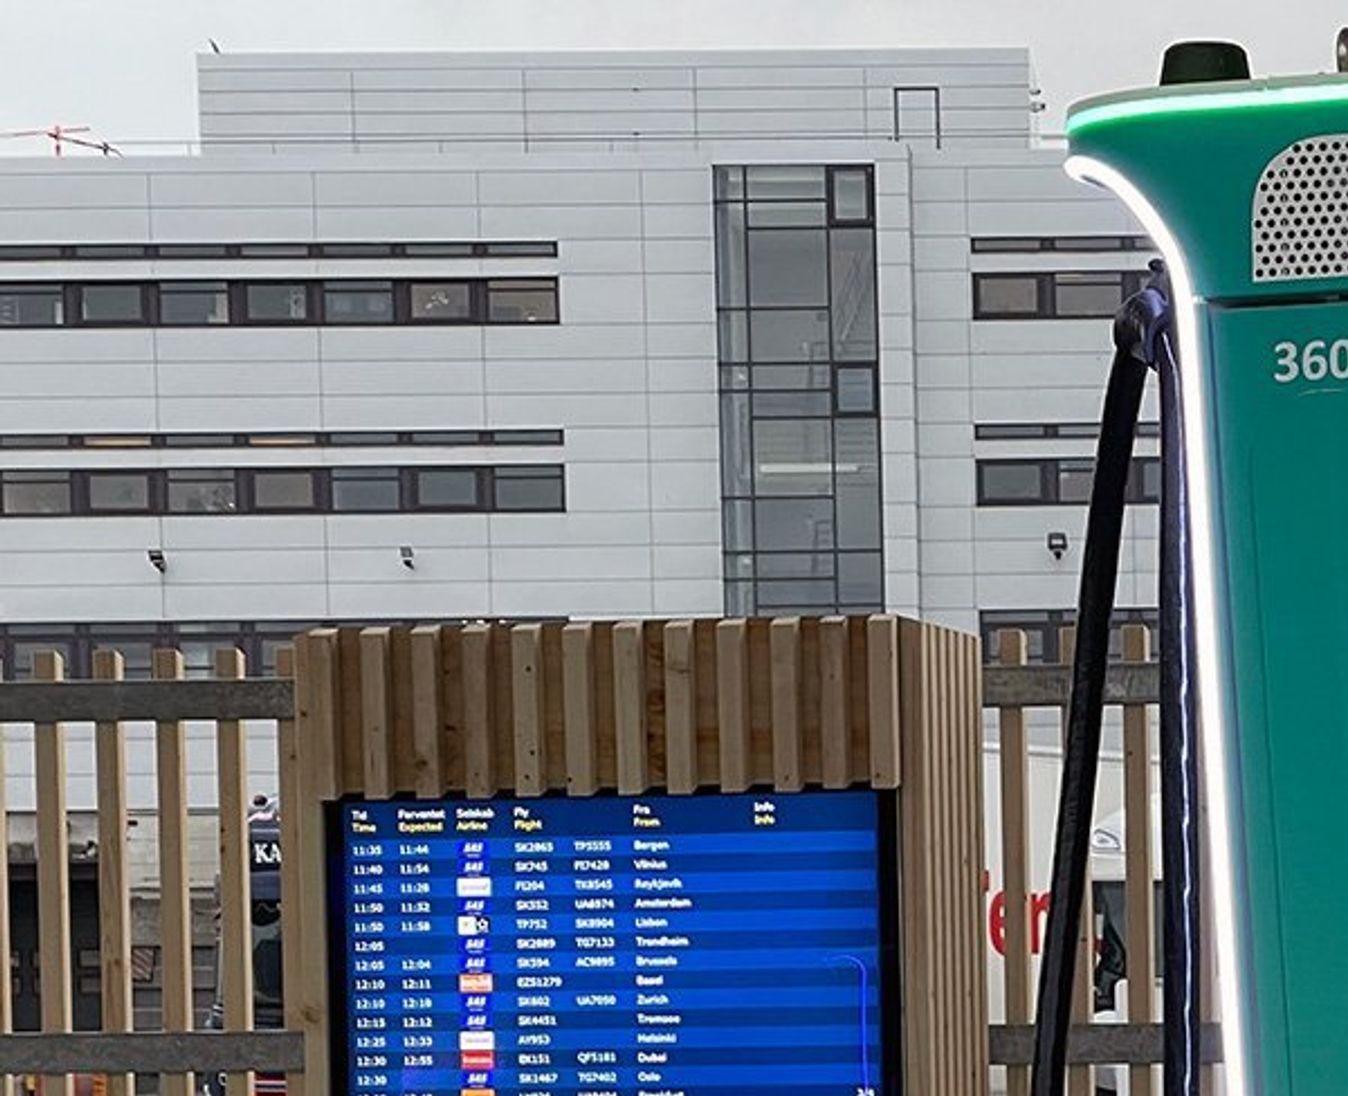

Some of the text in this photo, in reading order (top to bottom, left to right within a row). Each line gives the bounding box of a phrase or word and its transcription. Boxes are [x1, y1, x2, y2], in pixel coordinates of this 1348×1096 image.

[352, 810, 367, 820] Tid
[352, 822, 376, 832] Time
[398, 822, 443, 833] Expected
[456, 821, 488, 830] Airline
[514, 819, 542, 831] Flight
[633, 817, 661, 827] From
[634, 840, 669, 851] Bergen
[634, 860, 667, 869] Vilnius
[635, 879, 682, 890] Reykjavik
[635, 898, 691, 908] Amsterdam
[636, 918, 667, 928] Lisbon
[636, 937, 689, 946] Trondheim
[636, 956, 677, 966] Brussels
[636, 975, 663, 985] Basel
[637, 995, 668, 1004] Zurich
[638, 1014, 680, 1023] Tromsoe
[638, 1034, 676, 1042] Helsinki
[638, 1052, 667, 1063] Dubai
[638, 1072, 661, 1081] Oslo
